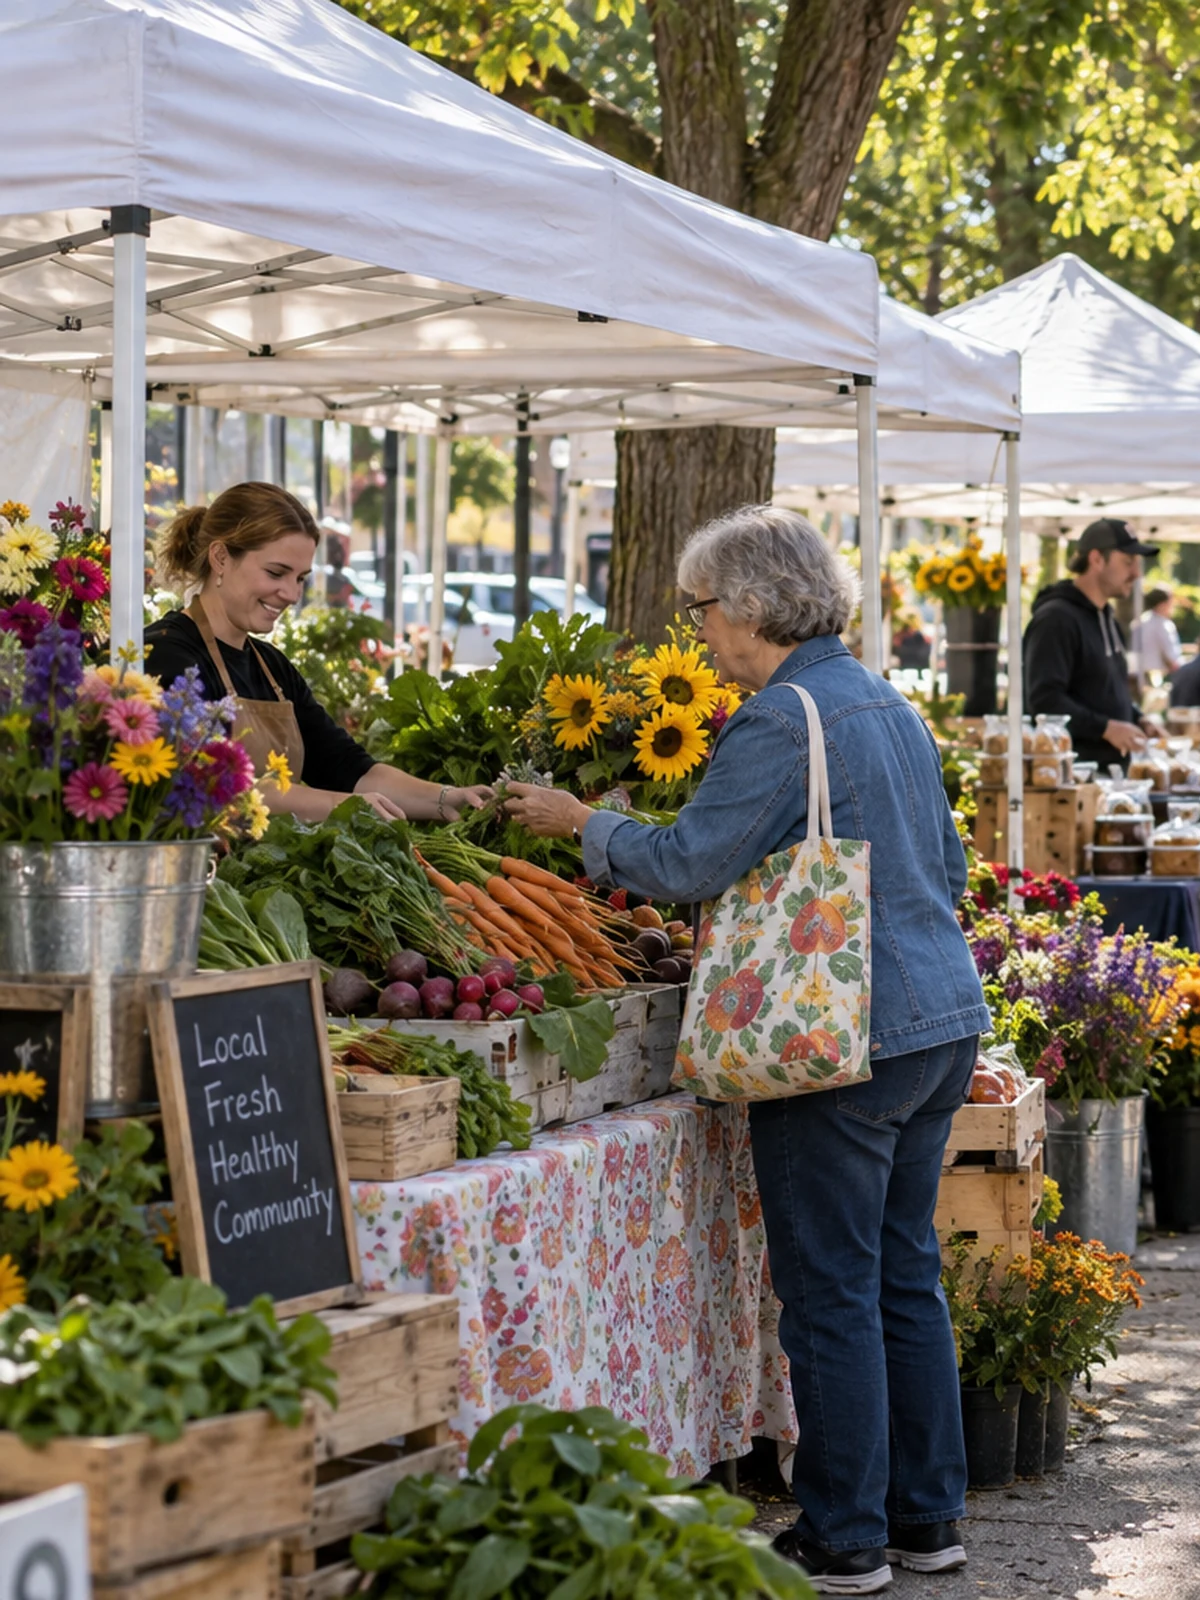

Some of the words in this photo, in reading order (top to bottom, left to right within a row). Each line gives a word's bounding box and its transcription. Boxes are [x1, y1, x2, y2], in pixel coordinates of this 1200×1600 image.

[194, 1014, 268, 1068] Local
[203, 1073, 283, 1127] Fresh
[208, 1130, 299, 1186] Healthy
[213, 1177, 334, 1244] Community
